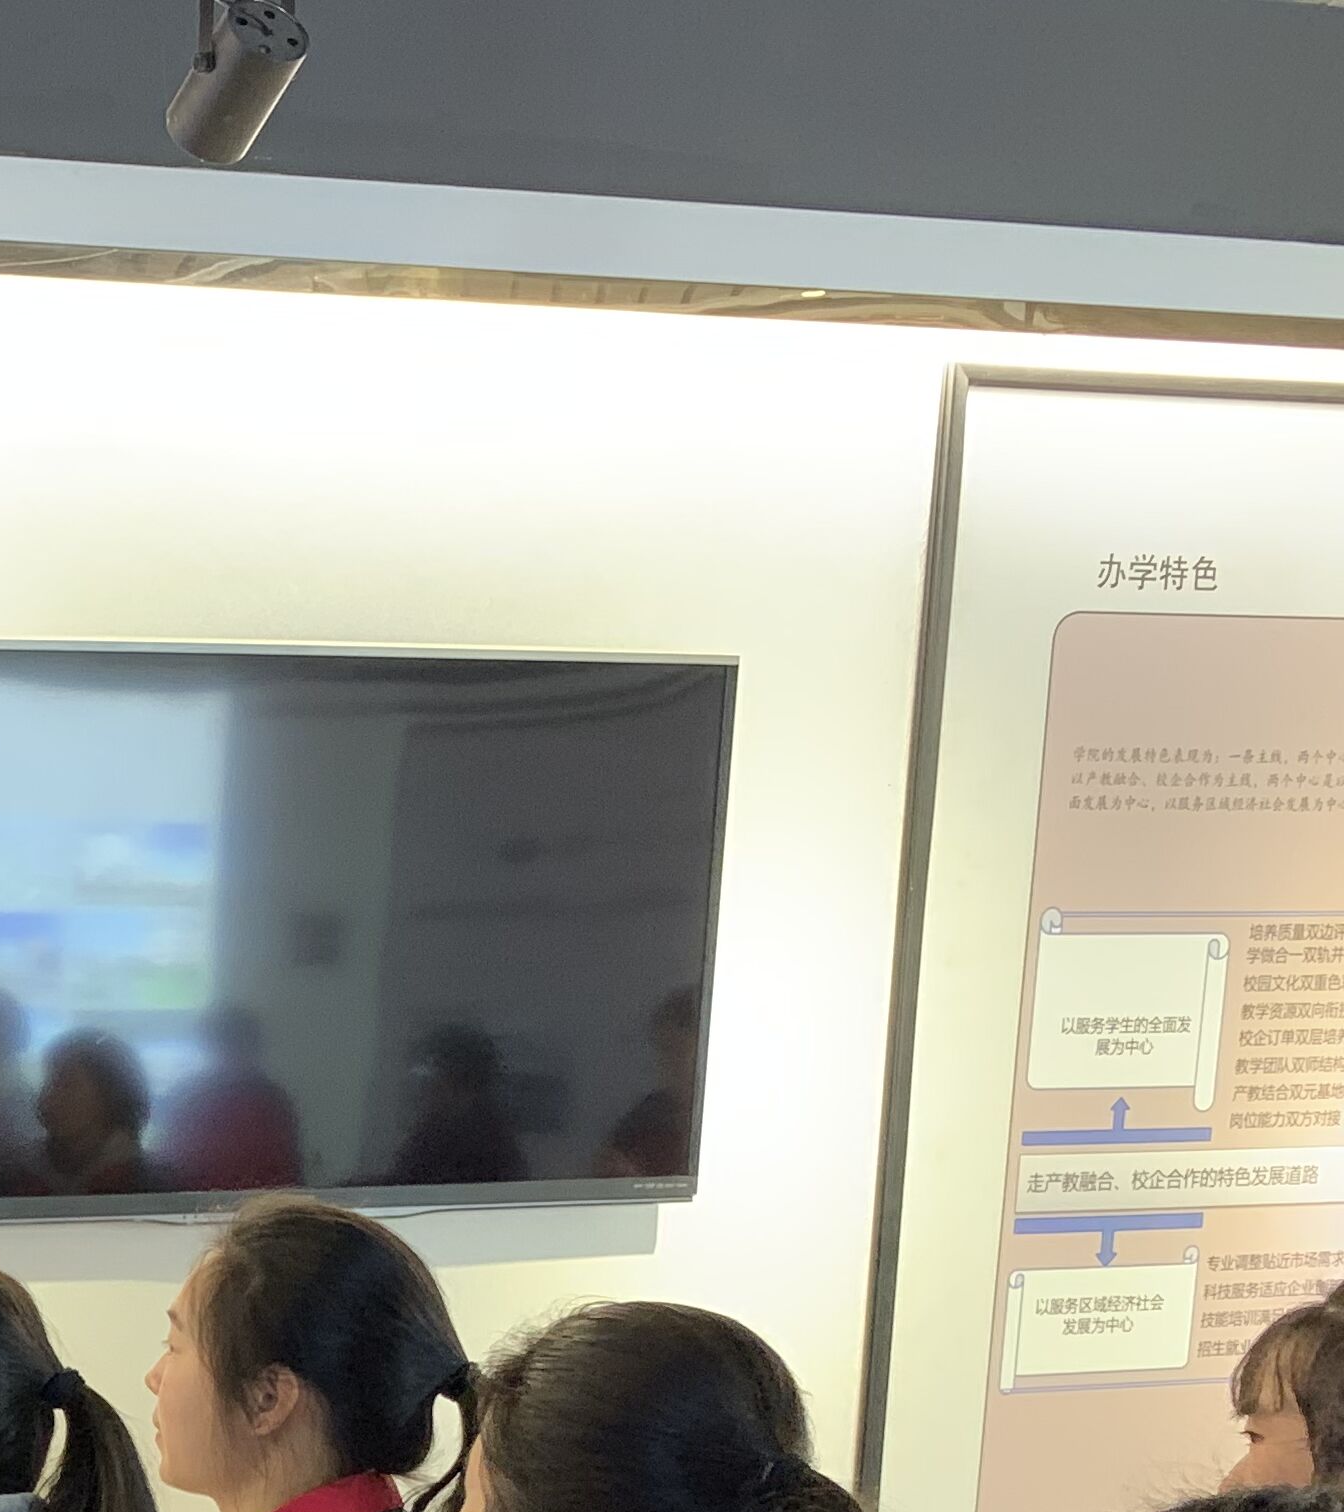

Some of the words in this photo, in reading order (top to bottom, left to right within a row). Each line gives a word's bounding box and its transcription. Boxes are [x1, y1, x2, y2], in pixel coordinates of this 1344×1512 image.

[1097, 553, 1218, 591] 办学特色
[1244, 973, 1344, 993] 校园文化双重色
[1061, 1015, 1192, 1036] 以服务学生的全面发
[1095, 1037, 1154, 1058] 展为中心
[1229, 1110, 1341, 1130] 岗位能力双方对接
[1027, 1164, 1319, 1194] 走产教融合、校企合作的特色发展道路
[1035, 1294, 1164, 1317] 以服务区域经济社会
[1062, 1316, 1134, 1335] 发展为中心
